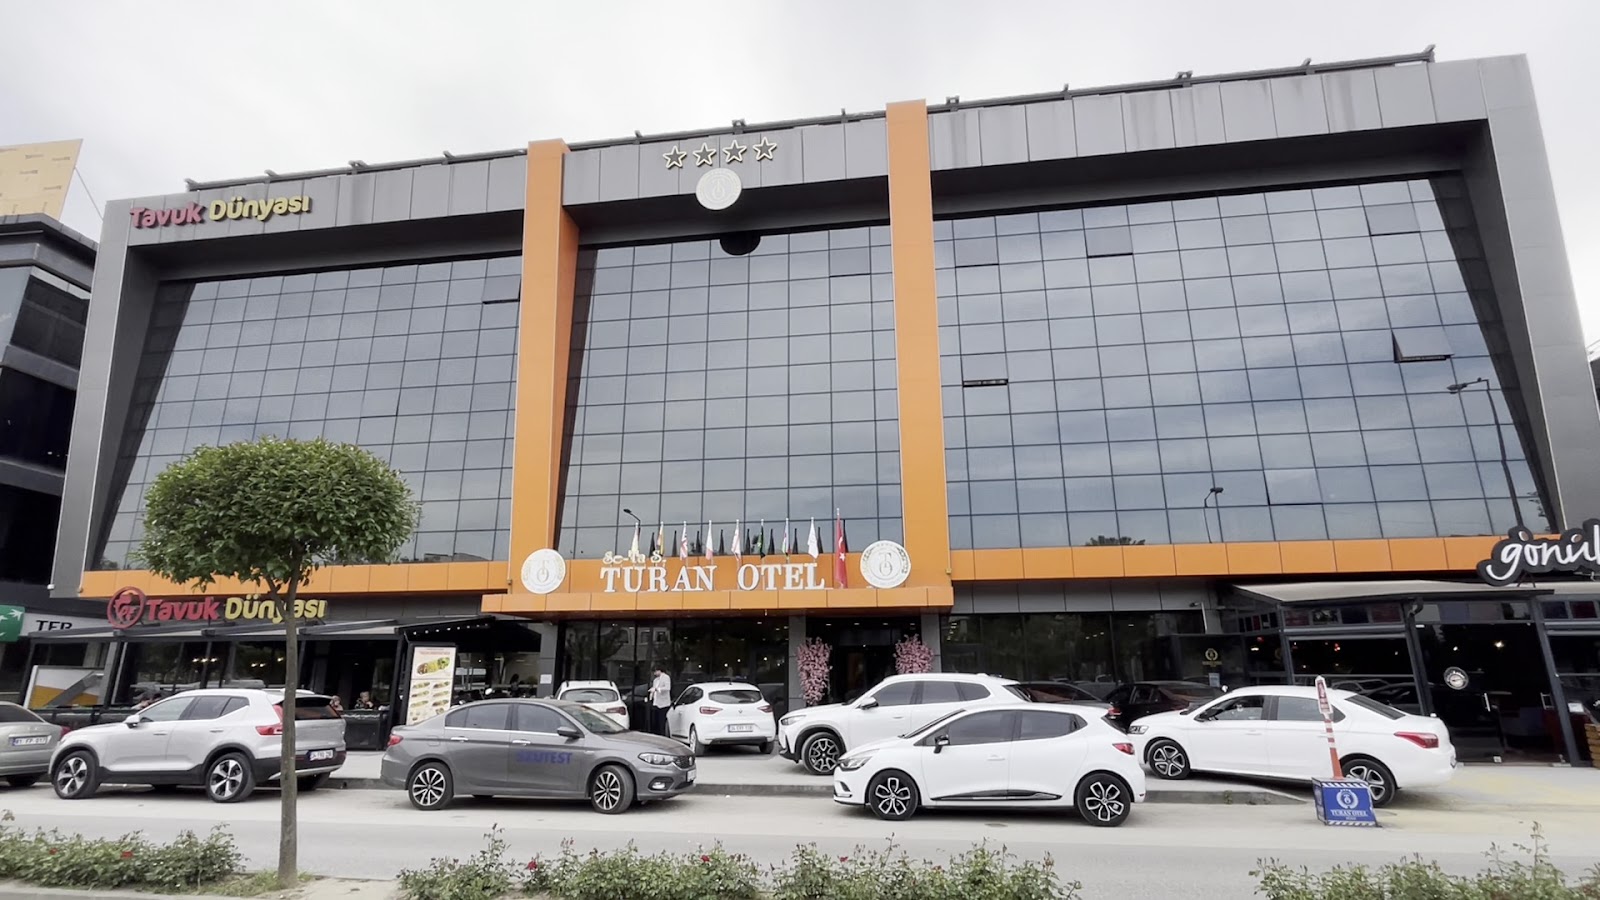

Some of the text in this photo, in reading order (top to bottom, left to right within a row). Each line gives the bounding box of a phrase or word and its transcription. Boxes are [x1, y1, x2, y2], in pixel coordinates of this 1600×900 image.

[130, 195, 311, 228] Tavuk Dünyası
[600, 562, 825, 592] TURAN OTEL
[146, 596, 220, 621] Tavuk
